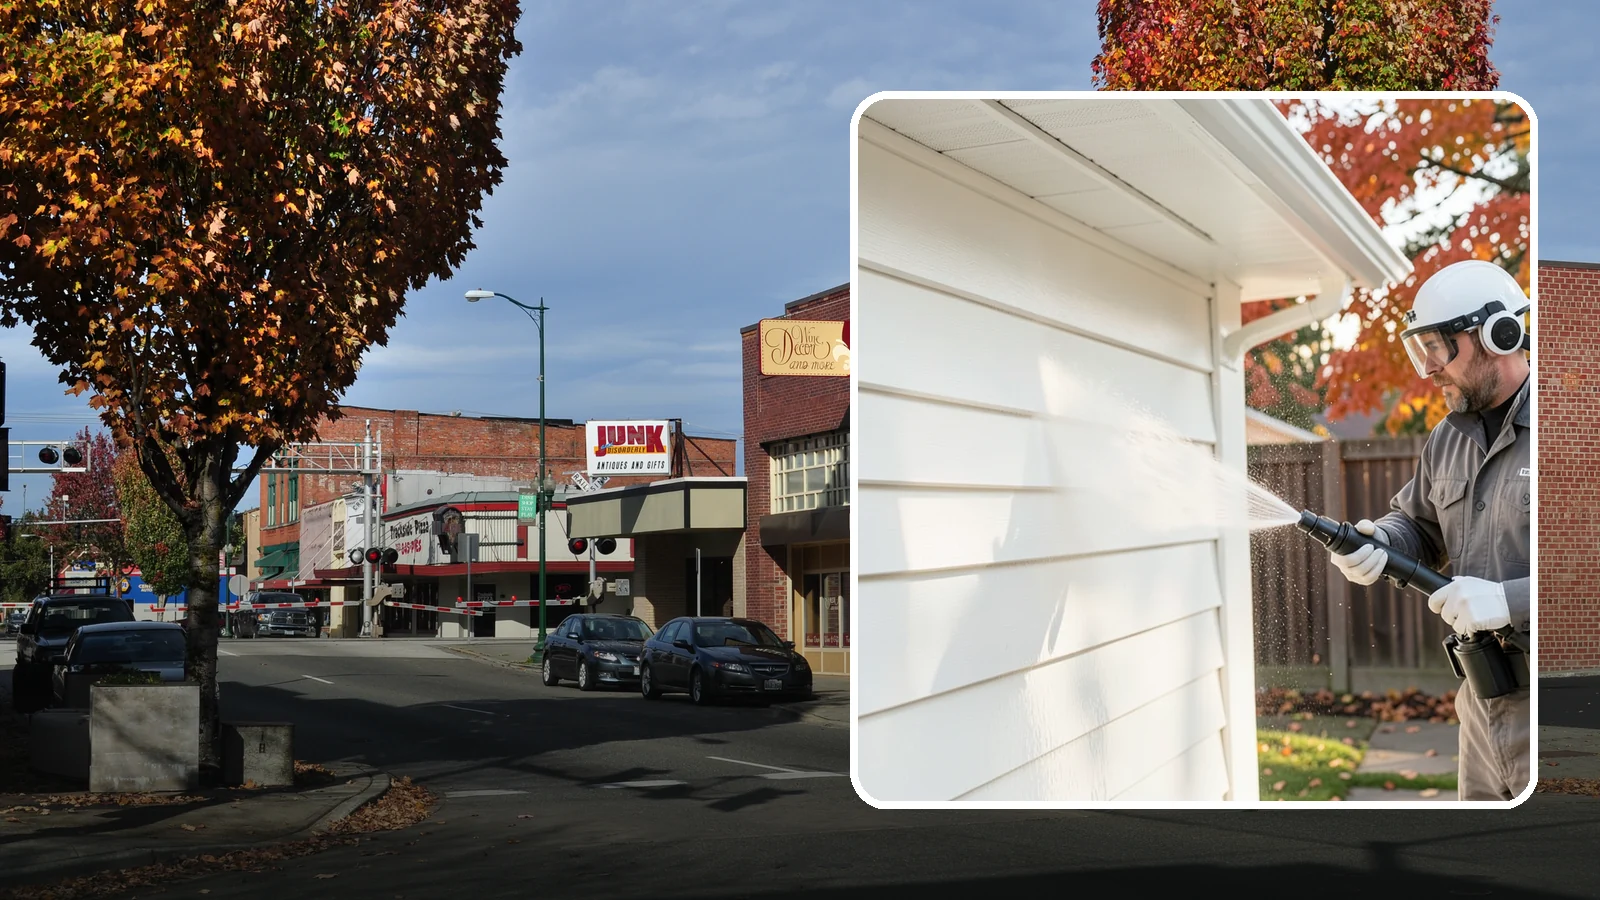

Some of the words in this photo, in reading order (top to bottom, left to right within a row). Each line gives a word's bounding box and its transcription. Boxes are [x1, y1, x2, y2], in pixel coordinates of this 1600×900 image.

[765, 327, 831, 366] Decor
[595, 425, 665, 457] JUNK
[607, 446, 646, 454] DISORDERLY
[597, 461, 628, 470] ANTIQUES
[631, 461, 644, 470] AND
[646, 460, 666, 470] GIFTS
[414, 520, 429, 535] Pizza
